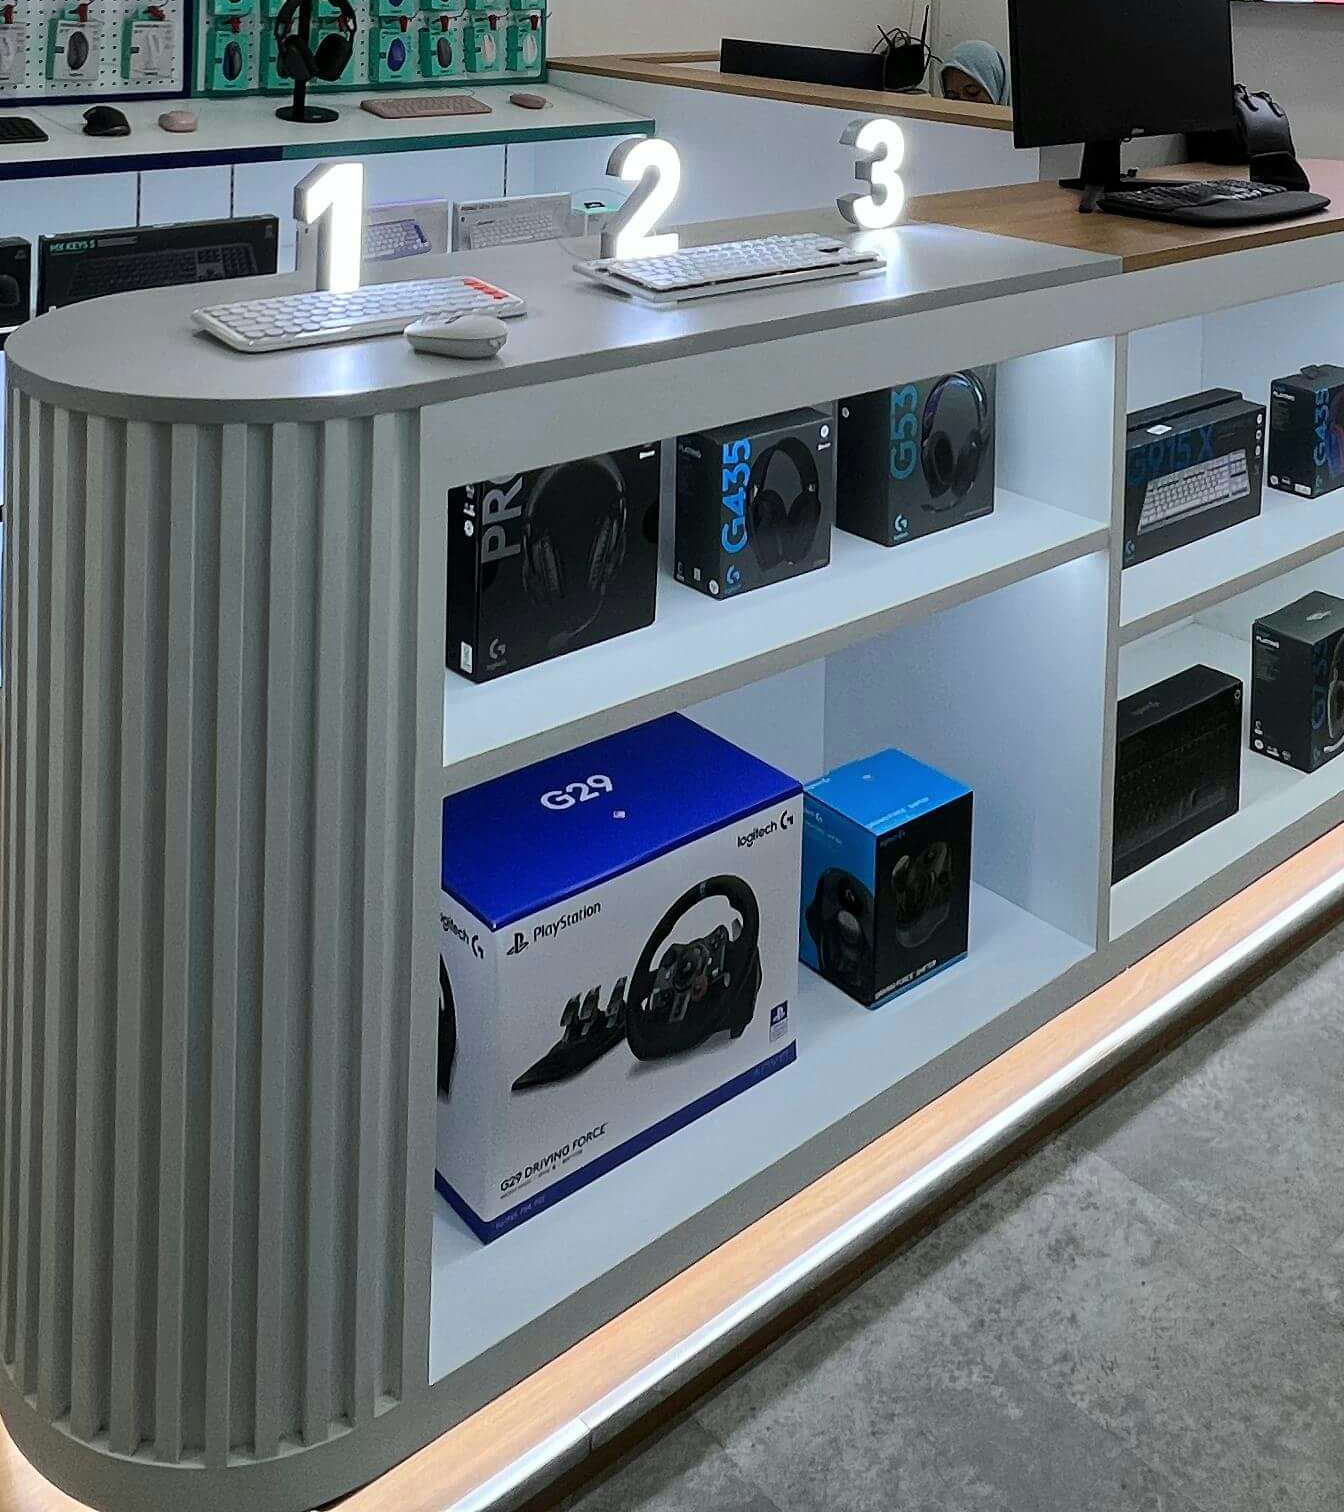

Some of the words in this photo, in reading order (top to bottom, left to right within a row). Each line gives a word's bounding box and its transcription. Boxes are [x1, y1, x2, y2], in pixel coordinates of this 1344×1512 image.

[601, 137, 682, 258] 2
[838, 118, 906, 230] 3
[293, 161, 365, 292] 1
[889, 382, 918, 480] G53
[480, 475, 524, 564] PR
[721, 436, 753, 554] G435
[540, 773, 615, 812] G29
[737, 821, 777, 848] logitech
[532, 901, 602, 943] PlayStation
[500, 1171, 523, 1192] G29
[572, 1121, 609, 1151] FORCE
